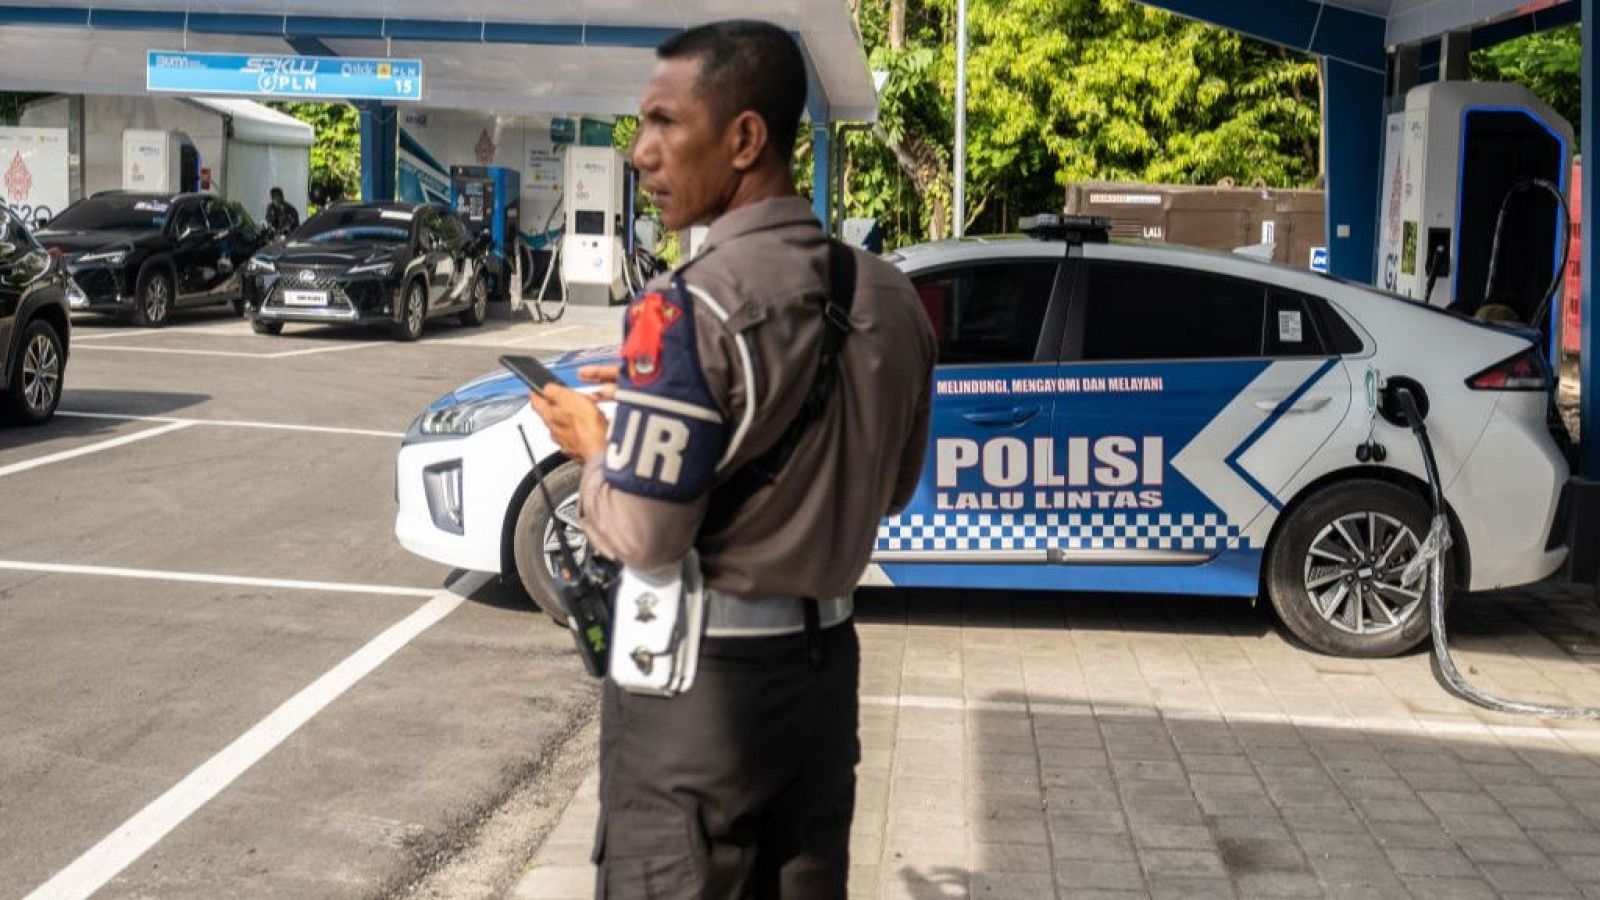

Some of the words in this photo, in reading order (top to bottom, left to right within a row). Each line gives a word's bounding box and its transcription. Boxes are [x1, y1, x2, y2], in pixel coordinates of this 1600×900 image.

[393, 67, 416, 77] PLN
[279, 75, 317, 91] PLN
[395, 79, 413, 93] 15
[936, 379, 1010, 395] MELINDUNGI,
[1012, 378, 1080, 393] MENGAYOMI
[1082, 377, 1106, 392] DAN
[1108, 376, 1163, 391] MELAYANI
[606, 409, 690, 484] JR
[936, 435, 1164, 488] POLISI
[936, 491, 1025, 510] LALU
[1034, 490, 1163, 510] LINTAS
